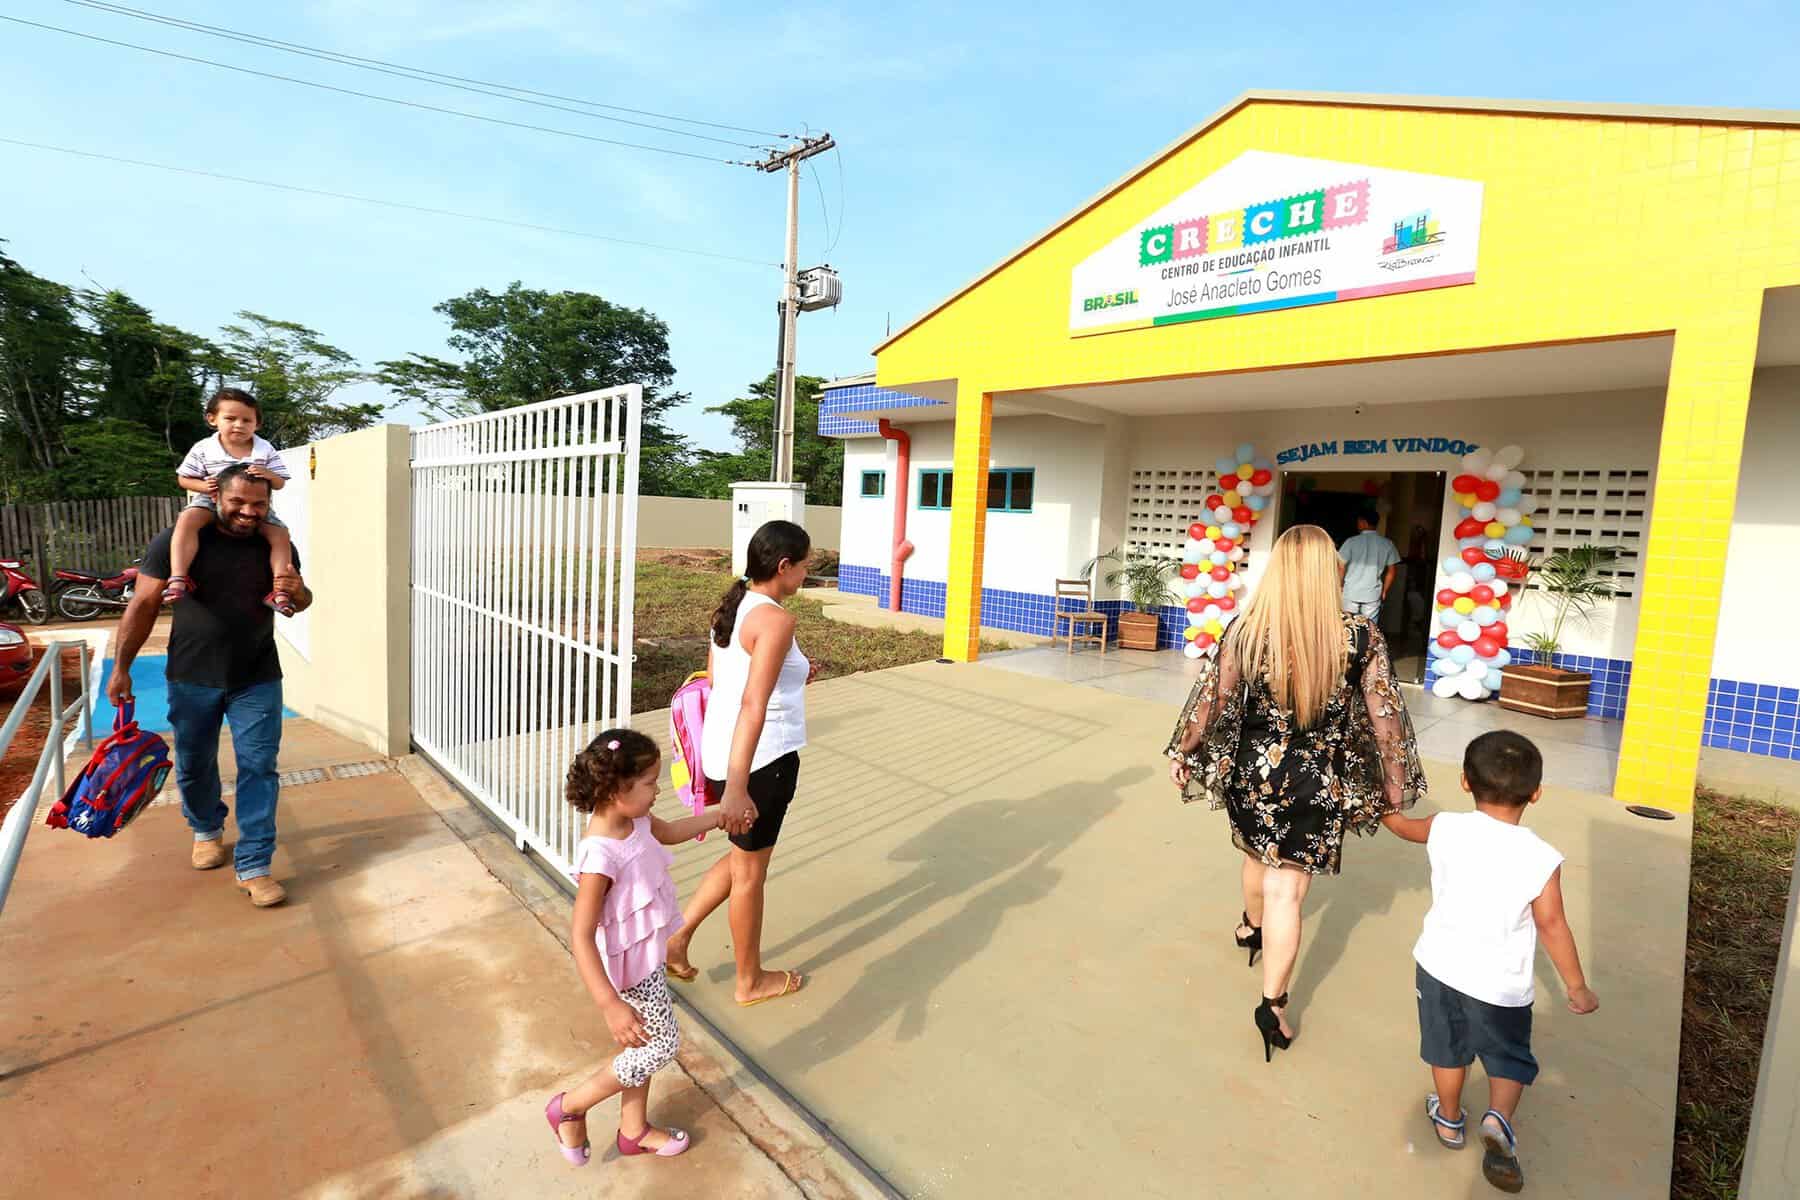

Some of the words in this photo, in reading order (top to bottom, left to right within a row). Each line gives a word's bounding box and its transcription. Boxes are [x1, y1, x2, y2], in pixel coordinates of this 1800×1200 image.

[1146, 190, 1360, 257] CRECHE
[1161, 262, 1200, 280] CENTRO
[1202, 259, 1215, 273] DE
[1218, 247, 1275, 270] EDUCAÇÃO
[1279, 238, 1331, 258] INFANTIL
[1083, 290, 1139, 312] BRASIL
[1167, 285, 1198, 307] José
[1200, 277, 1262, 302] Anacleto
[1266, 268, 1322, 292] Gomes
[1276, 441, 1338, 465] SEJAM
[1343, 439, 1387, 455] BEM
